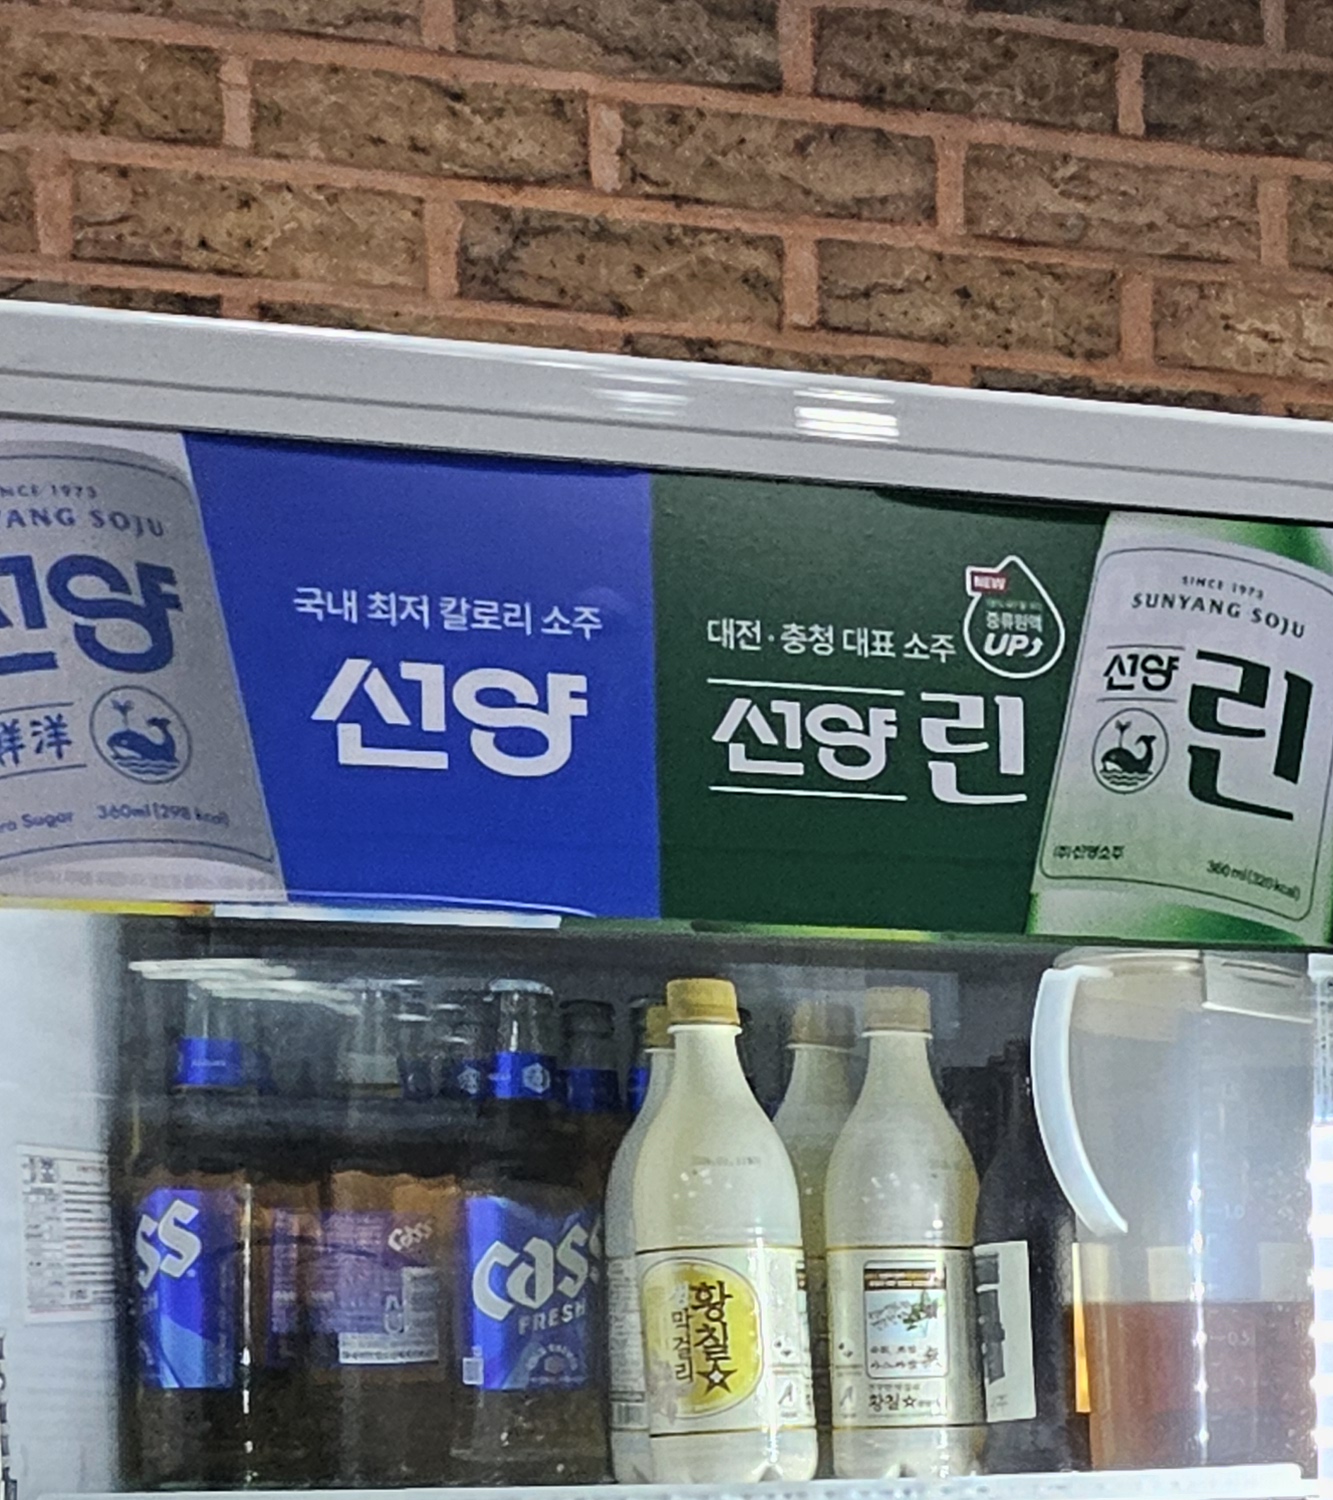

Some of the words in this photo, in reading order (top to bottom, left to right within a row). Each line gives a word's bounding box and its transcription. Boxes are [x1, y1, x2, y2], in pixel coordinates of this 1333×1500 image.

[90, 508, 164, 538] SOJU
[974, 575, 1006, 590] NEW
[1182, 575, 1224, 591] SINCE
[1232, 582, 1264, 600] 1973
[293, 586, 358, 624] 국내
[367, 591, 430, 629] 최저
[439, 594, 533, 636] 칼로리
[541, 599, 603, 641] 소주
[1131, 593, 1241, 618] SUNYANG
[1251, 608, 1306, 638] SOJU
[843, 625, 896, 660] 대표
[903, 630, 957, 664] 소주
[983, 632, 1030, 656] UP
[1104, 653, 1180, 691] 선양
[311, 657, 589, 778] 선양
[1188, 648, 1313, 821] 린
[712, 698, 897, 781] 선양
[921, 692, 1027, 804] 린
[518, 1298, 588, 1337] FRESH
[688, 1280, 734, 1361] 황칠
